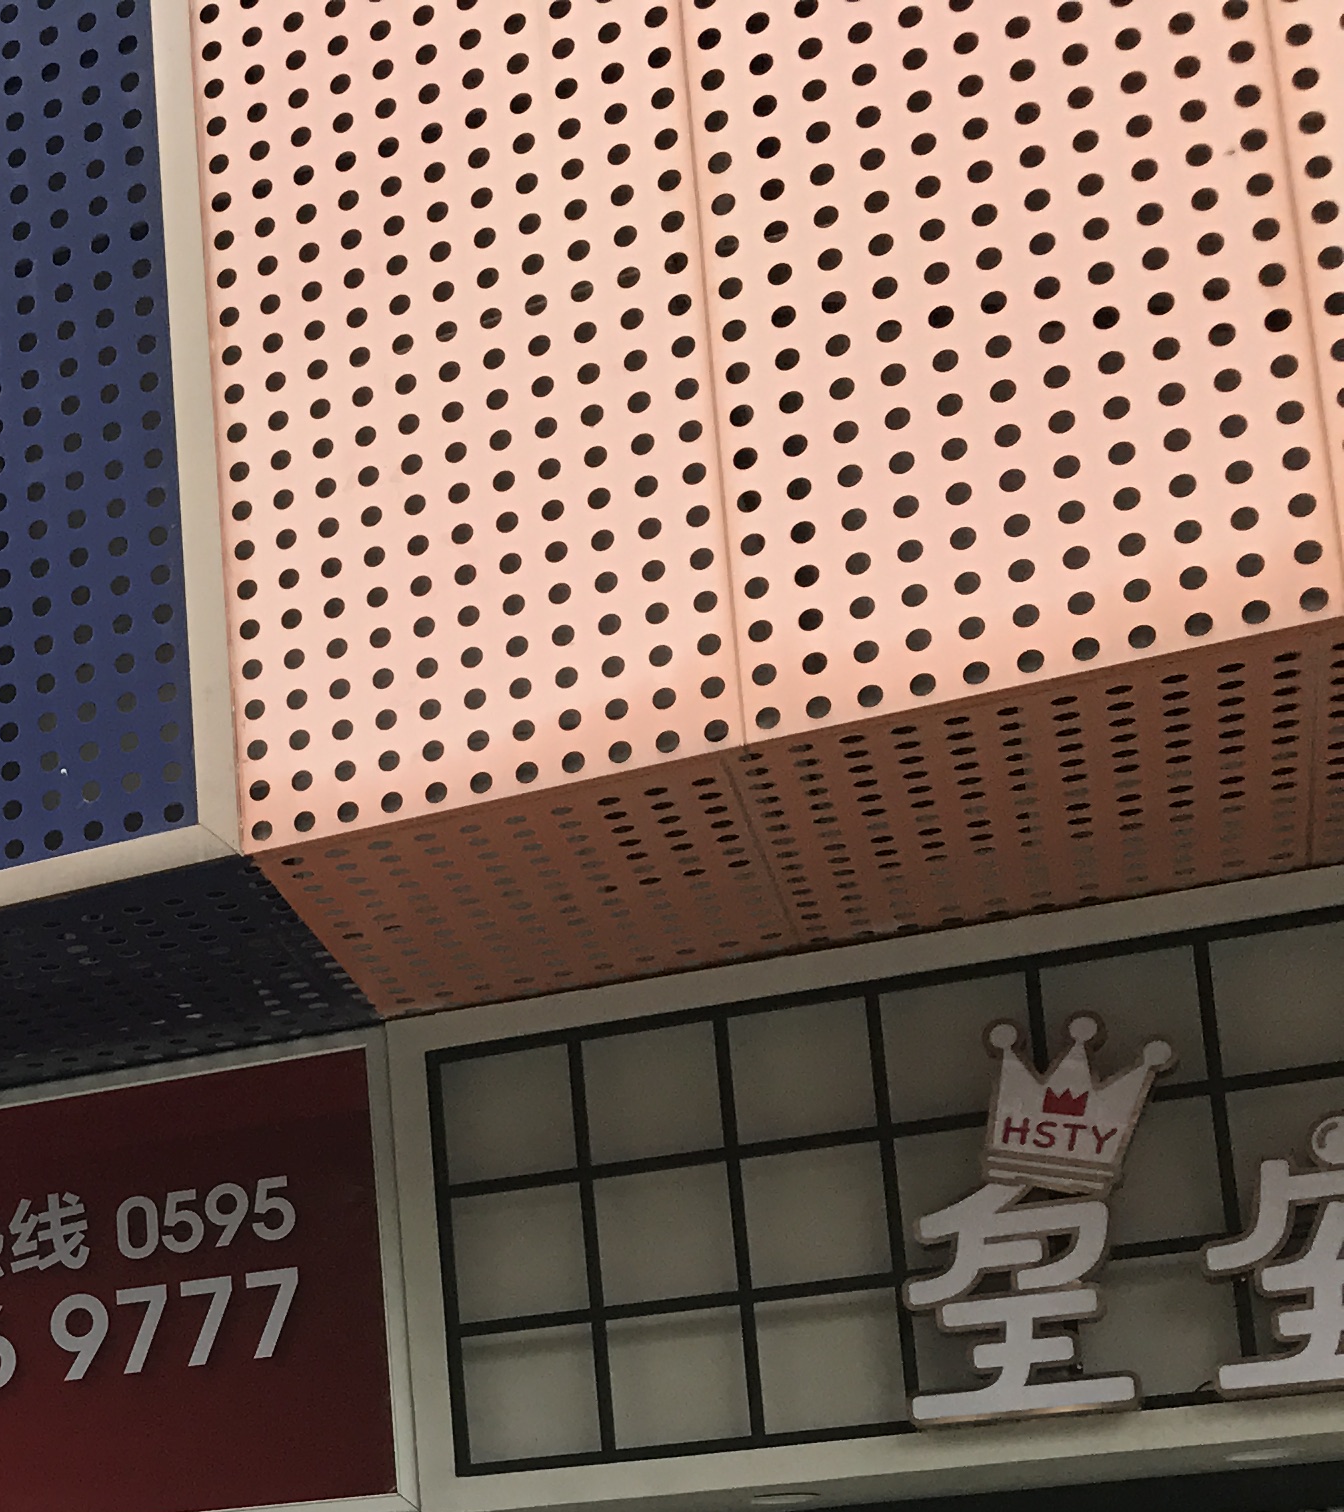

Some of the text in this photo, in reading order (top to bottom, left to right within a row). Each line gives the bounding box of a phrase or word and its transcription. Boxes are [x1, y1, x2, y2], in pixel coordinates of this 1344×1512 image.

[1001, 1117, 1117, 1155] HSTY
[115, 1175, 296, 1260] 0595
[49, 1266, 300, 1382] 9777
